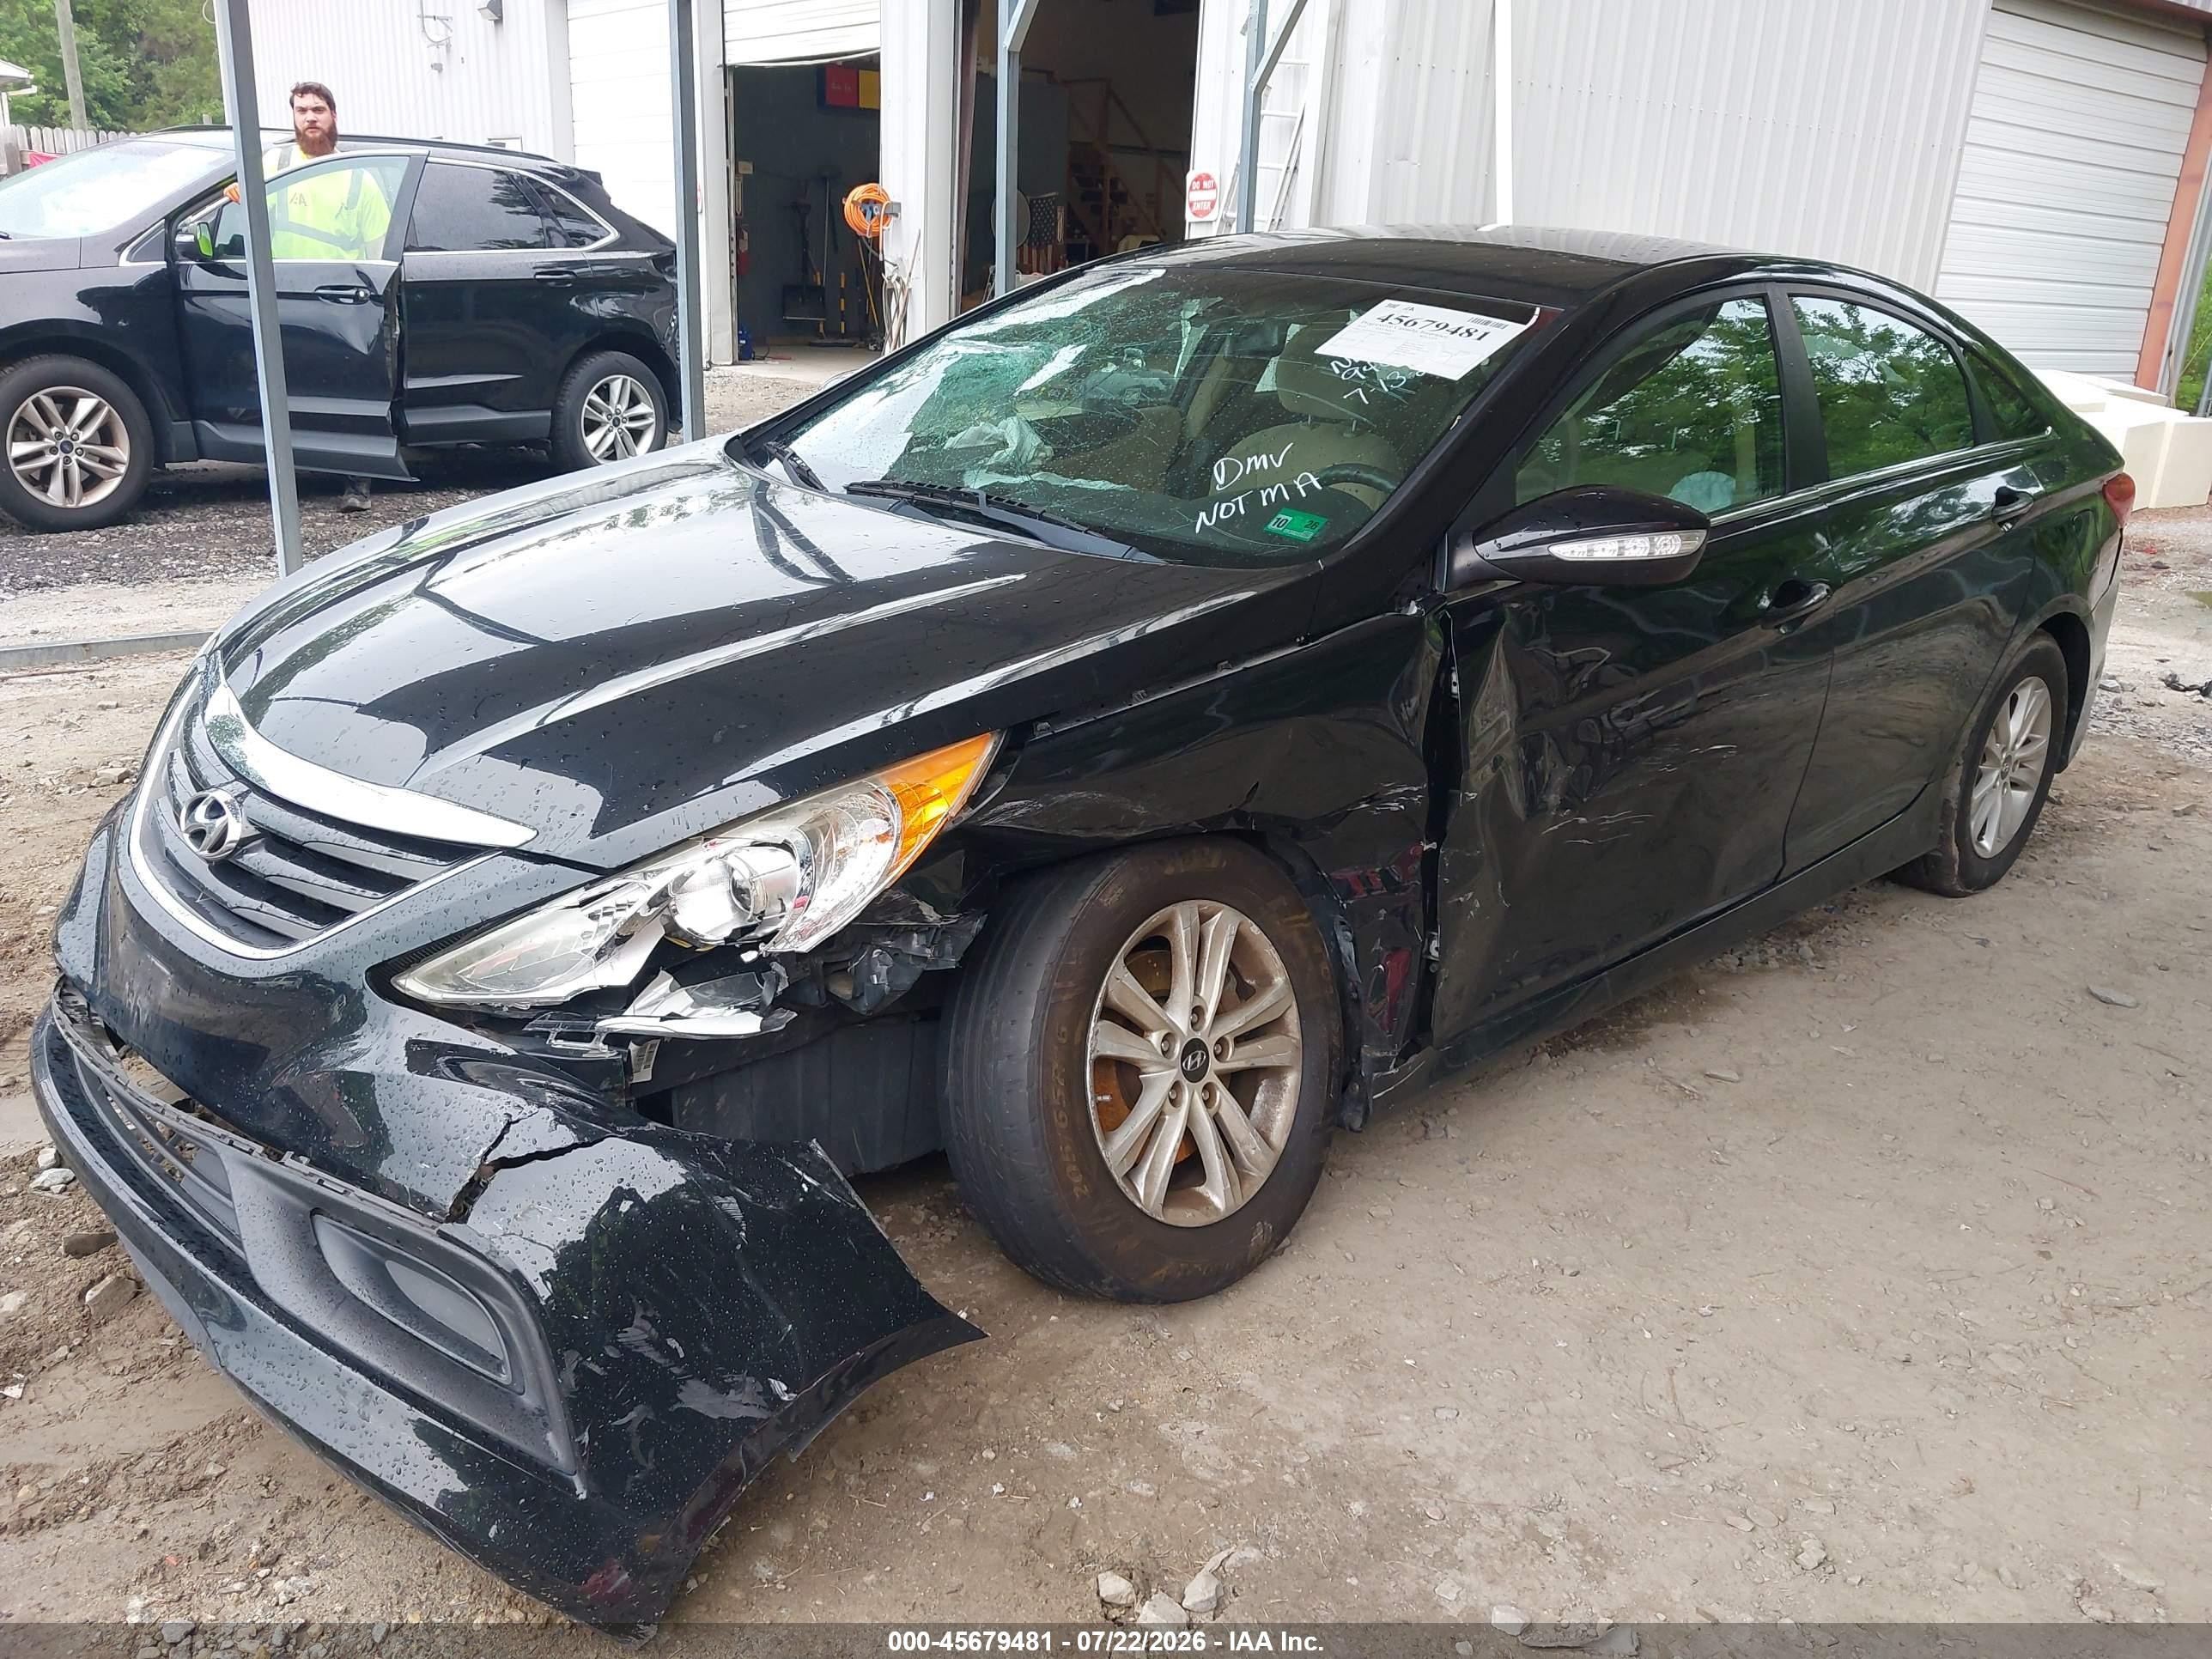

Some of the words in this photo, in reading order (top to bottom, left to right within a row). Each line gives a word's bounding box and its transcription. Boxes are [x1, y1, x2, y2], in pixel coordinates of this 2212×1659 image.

[1202, 179, 1215, 190] NOT
[1194, 201, 1211, 211] ENTER
[1376, 313, 1492, 341] 45679481
[1195, 490, 1254, 533] NOT
[1272, 517, 1289, 528] 10
[1304, 520, 1320, 530] 26
